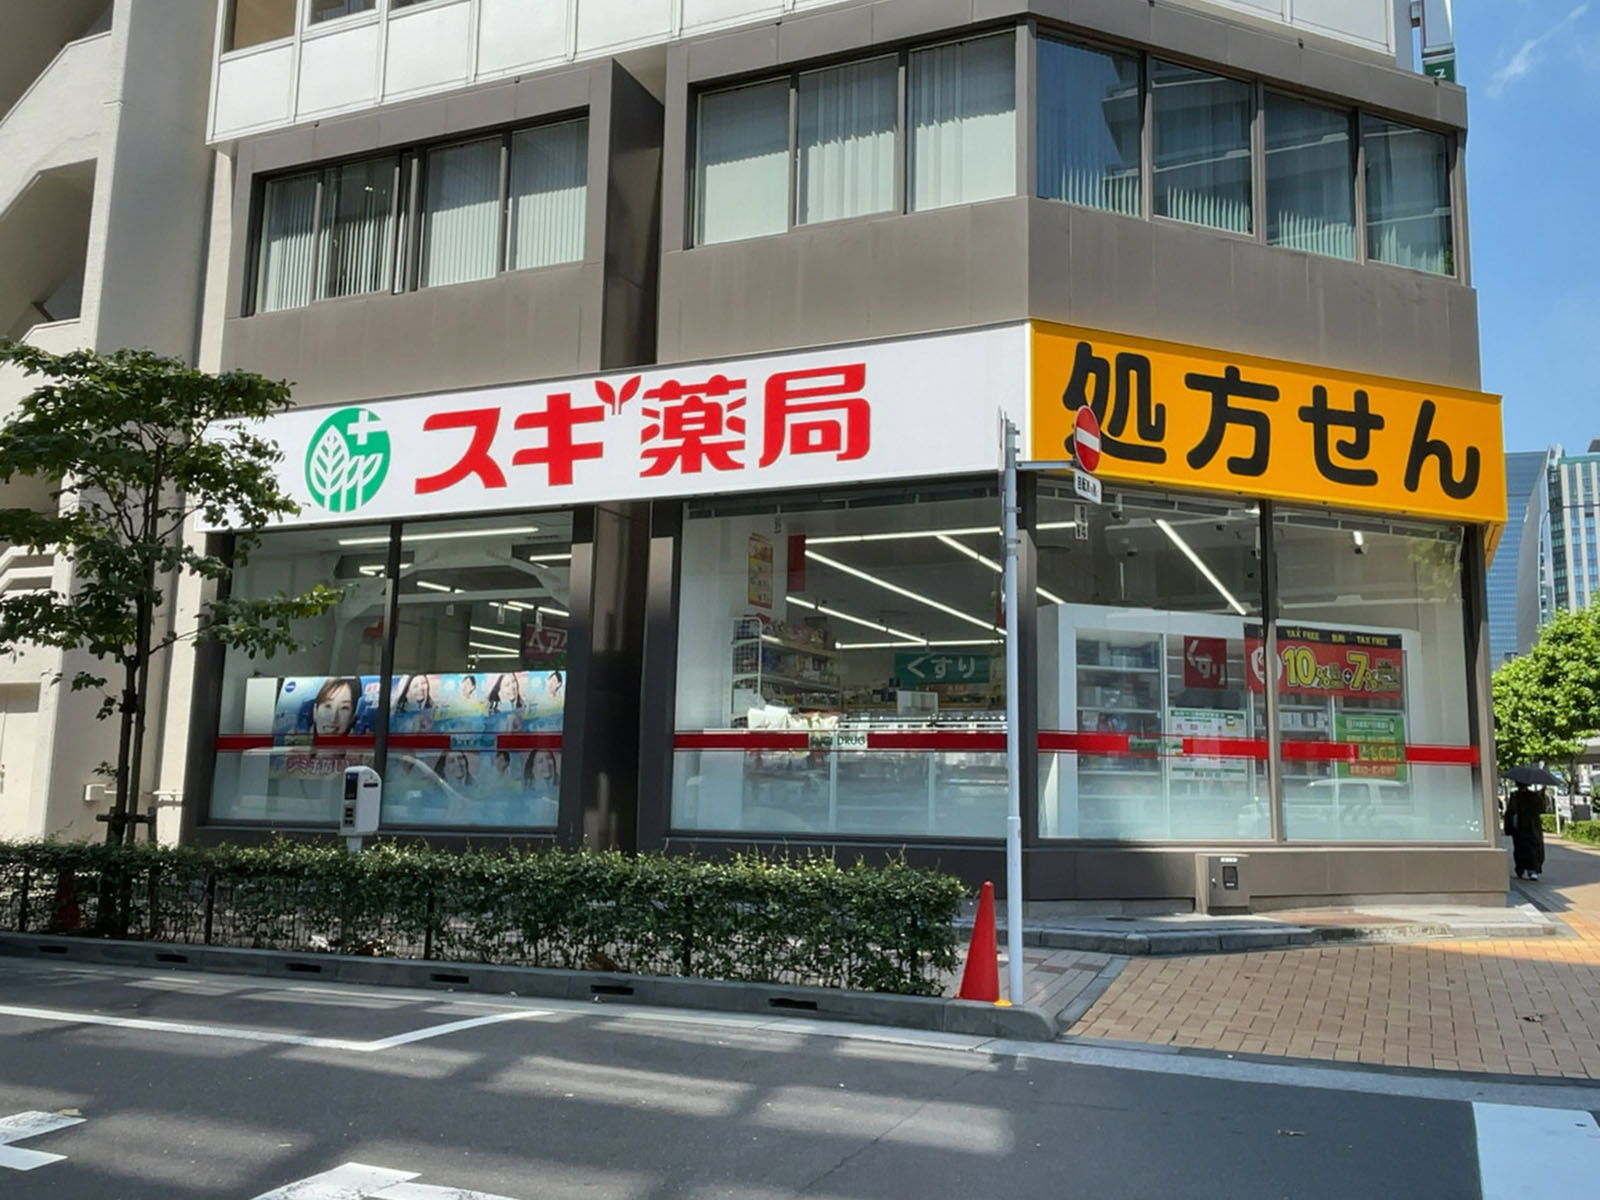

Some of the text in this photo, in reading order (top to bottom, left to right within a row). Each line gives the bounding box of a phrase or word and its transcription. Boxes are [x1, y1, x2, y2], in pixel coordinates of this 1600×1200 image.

[414, 363, 871, 494] スギ薬局
[1062, 341, 1480, 499] 処方せん
[1286, 629, 1320, 641] TAX FREE
[1356, 635, 1371, 645] TAX
[907, 656, 976, 679] くすり
[1187, 640, 1226, 686] くすり
[837, 735, 866, 746] DRUG
